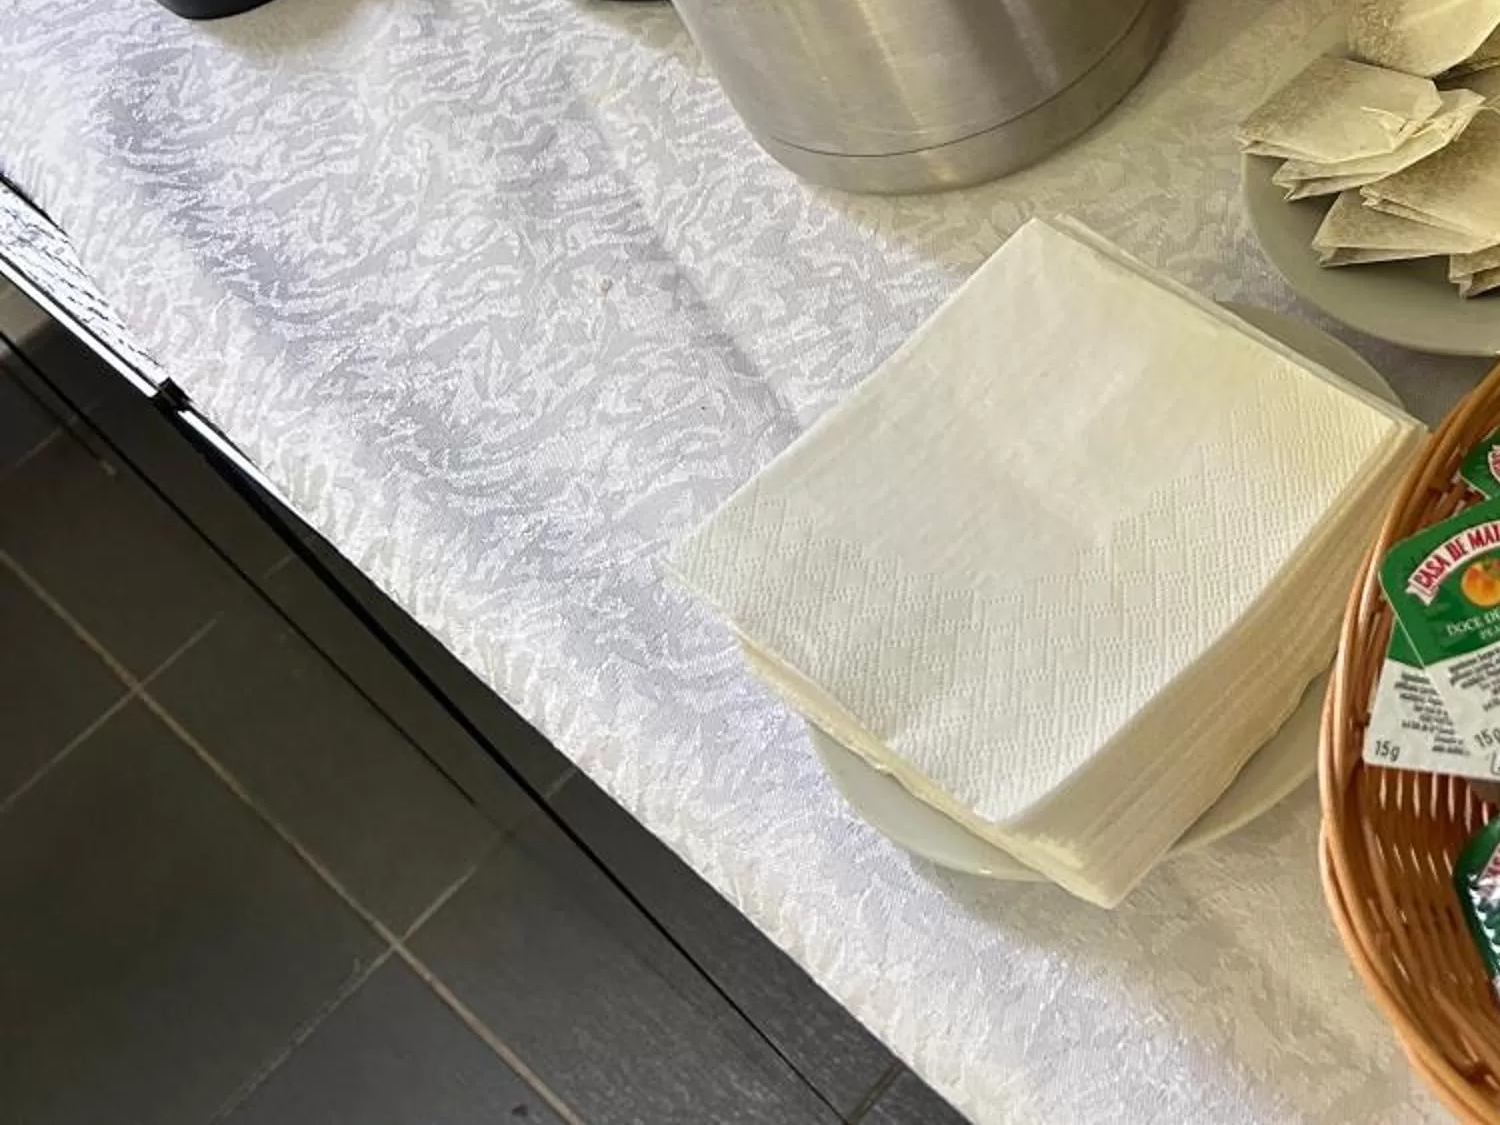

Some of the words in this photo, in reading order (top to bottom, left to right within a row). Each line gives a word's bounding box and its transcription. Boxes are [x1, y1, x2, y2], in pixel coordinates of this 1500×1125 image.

[1413, 555, 1450, 589] CASA
[1444, 538, 1470, 559] DE
[1446, 618, 1483, 638] DOCE
[1374, 739, 1400, 762] 15g
